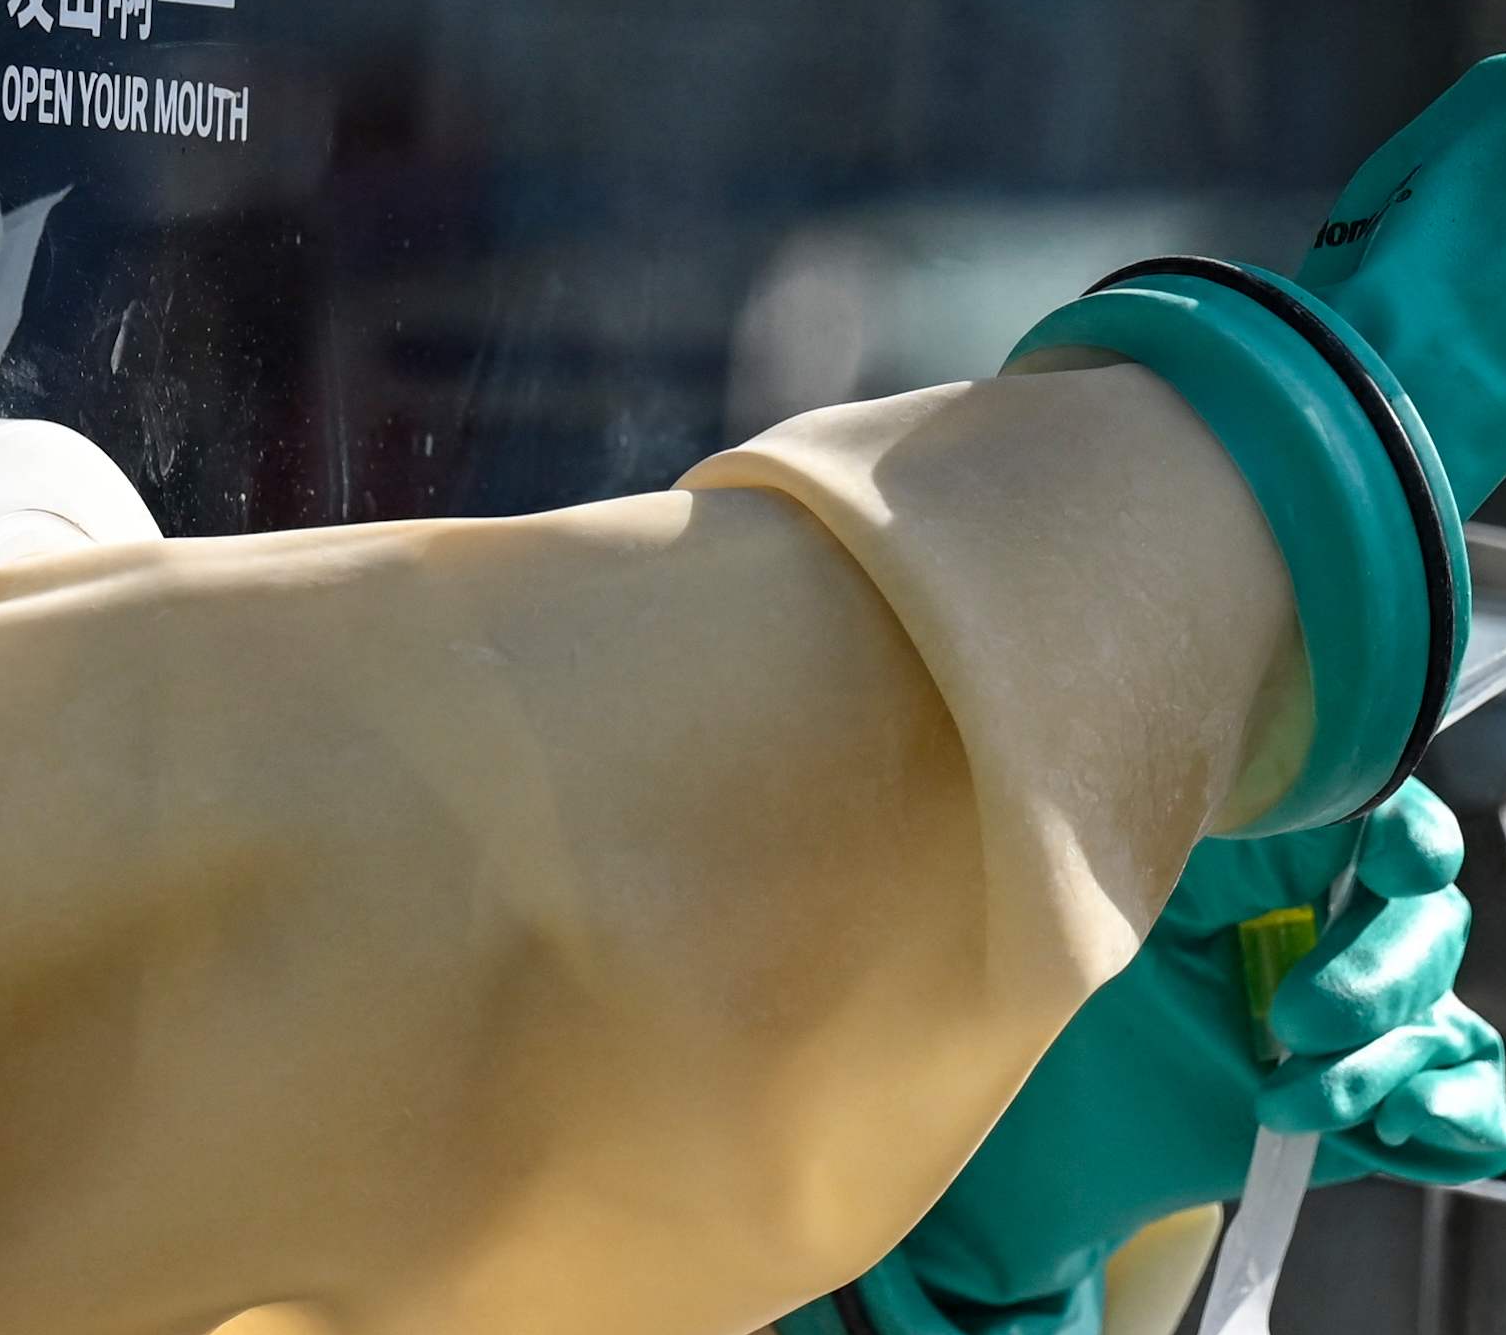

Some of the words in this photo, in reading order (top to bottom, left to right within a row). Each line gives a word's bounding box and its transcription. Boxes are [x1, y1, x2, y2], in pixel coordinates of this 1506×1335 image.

[2, 64, 74, 126] OPEN
[78, 71, 149, 133] YOUR
[154, 82, 250, 143] MOUTH
